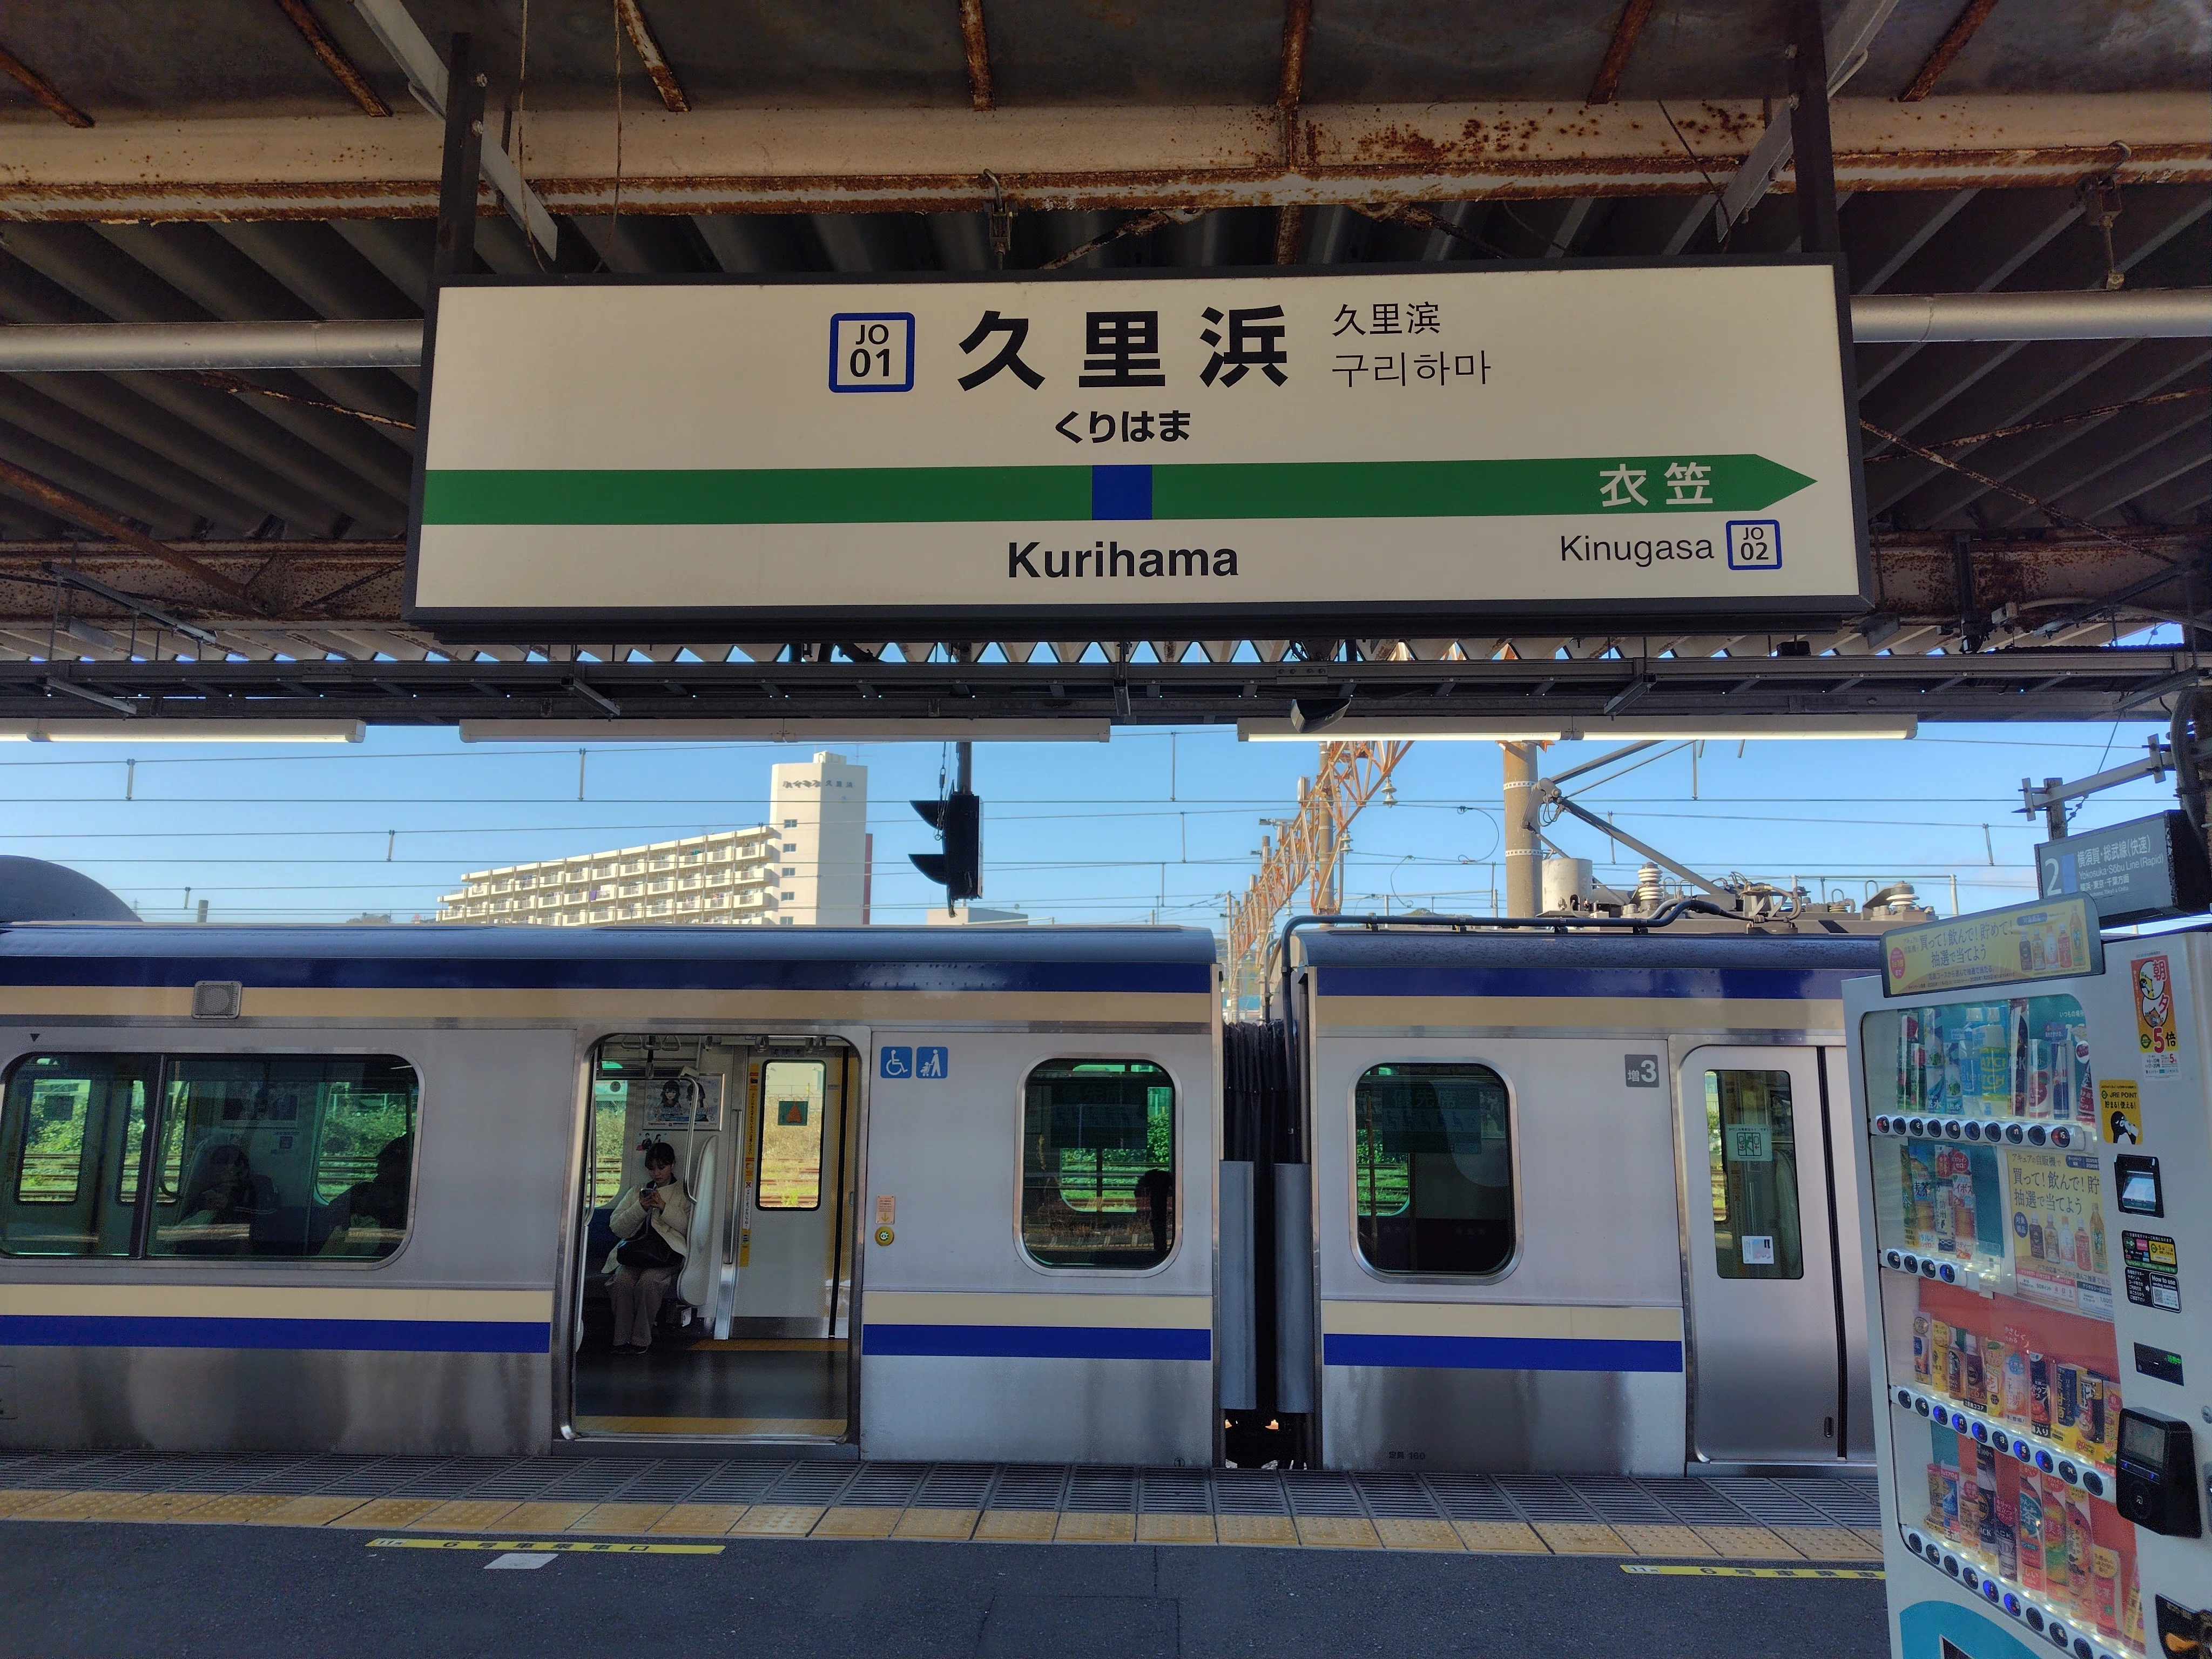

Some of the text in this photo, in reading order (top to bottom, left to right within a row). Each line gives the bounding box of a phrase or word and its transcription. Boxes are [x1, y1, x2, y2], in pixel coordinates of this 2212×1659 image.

[1333, 301, 1440, 336] 久里滨
[856, 325, 888, 345] JO
[958, 305, 1287, 391] 久里浜
[850, 349, 889, 377] 01
[1332, 350, 1491, 387] 구리하마
[1056, 410, 1190, 443] くりはま
[1600, 462, 1712, 507] 衣笠
[1743, 527, 1763, 540] JO
[1009, 542, 1237, 577] Kurihama
[1561, 536, 1714, 567] Kinugasa
[1741, 542, 1768, 560] 02
[2126, 860, 2140, 871] Line
[2140, 853, 2164, 868] (Rapid)
[2045, 858, 2062, 896] 2
[1931, 944, 1986, 968] 抽選で当てよう
[2153, 960, 2166, 981] 朝
[2159, 994, 2170, 1014] 夕
[2014, 1188, 2082, 1215] 抽選で当てよう
